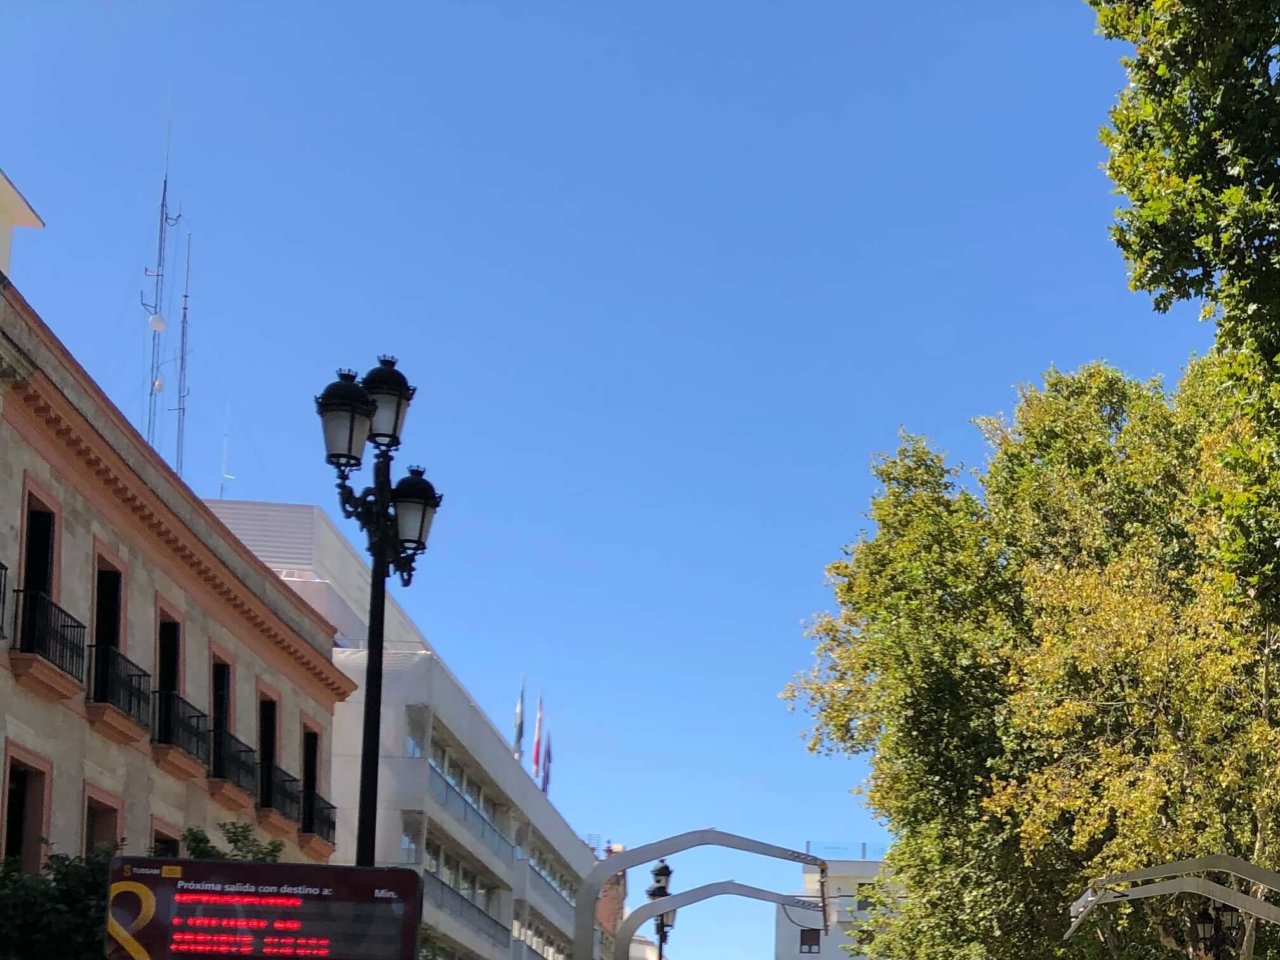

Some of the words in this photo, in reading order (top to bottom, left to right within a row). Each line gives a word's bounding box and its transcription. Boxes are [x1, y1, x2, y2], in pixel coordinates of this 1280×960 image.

[176, 879, 222, 892] Próxima
[223, 882, 256, 893] salida
[258, 885, 277, 894] con
[279, 884, 320, 895] destino
[321, 888, 333, 896] a:
[374, 888, 398, 898] Min.
